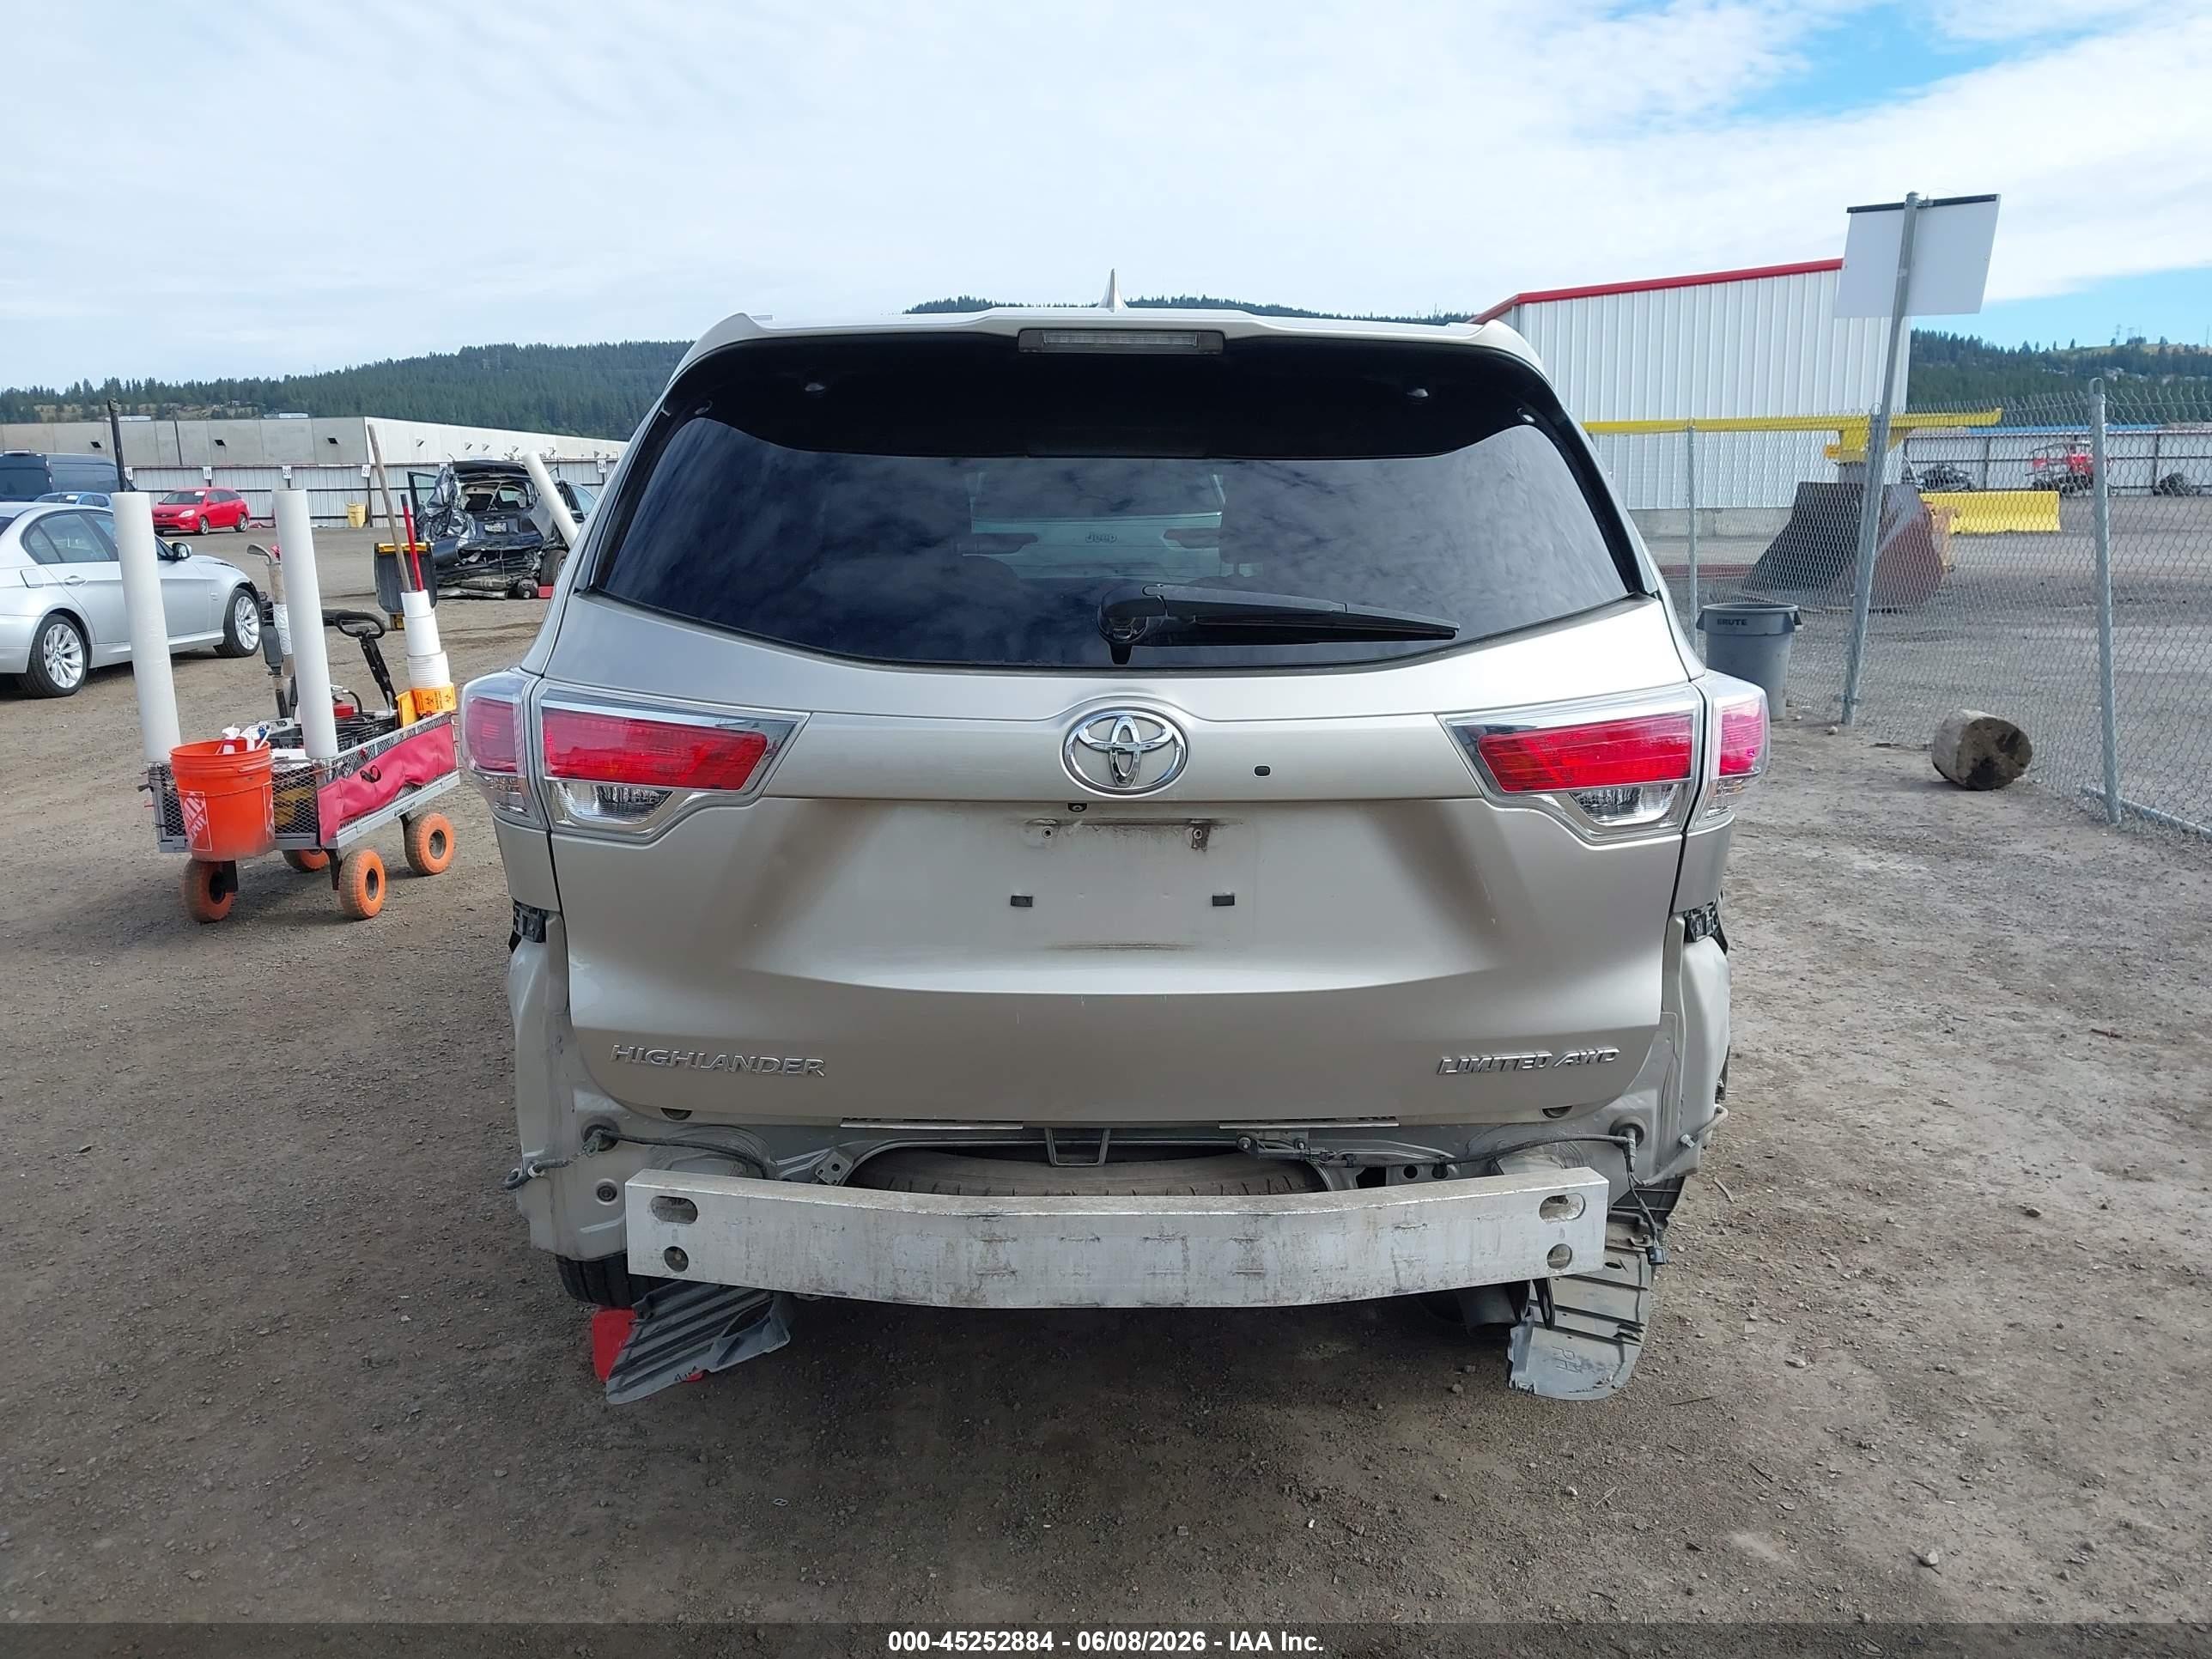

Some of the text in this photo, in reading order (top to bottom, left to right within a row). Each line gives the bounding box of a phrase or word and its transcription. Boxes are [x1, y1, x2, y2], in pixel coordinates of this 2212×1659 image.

[1085, 532, 1119, 544] Jeep
[609, 1044, 826, 1077] HIGHLANDER
[1437, 1045, 1620, 1074] LIMITED AWD
